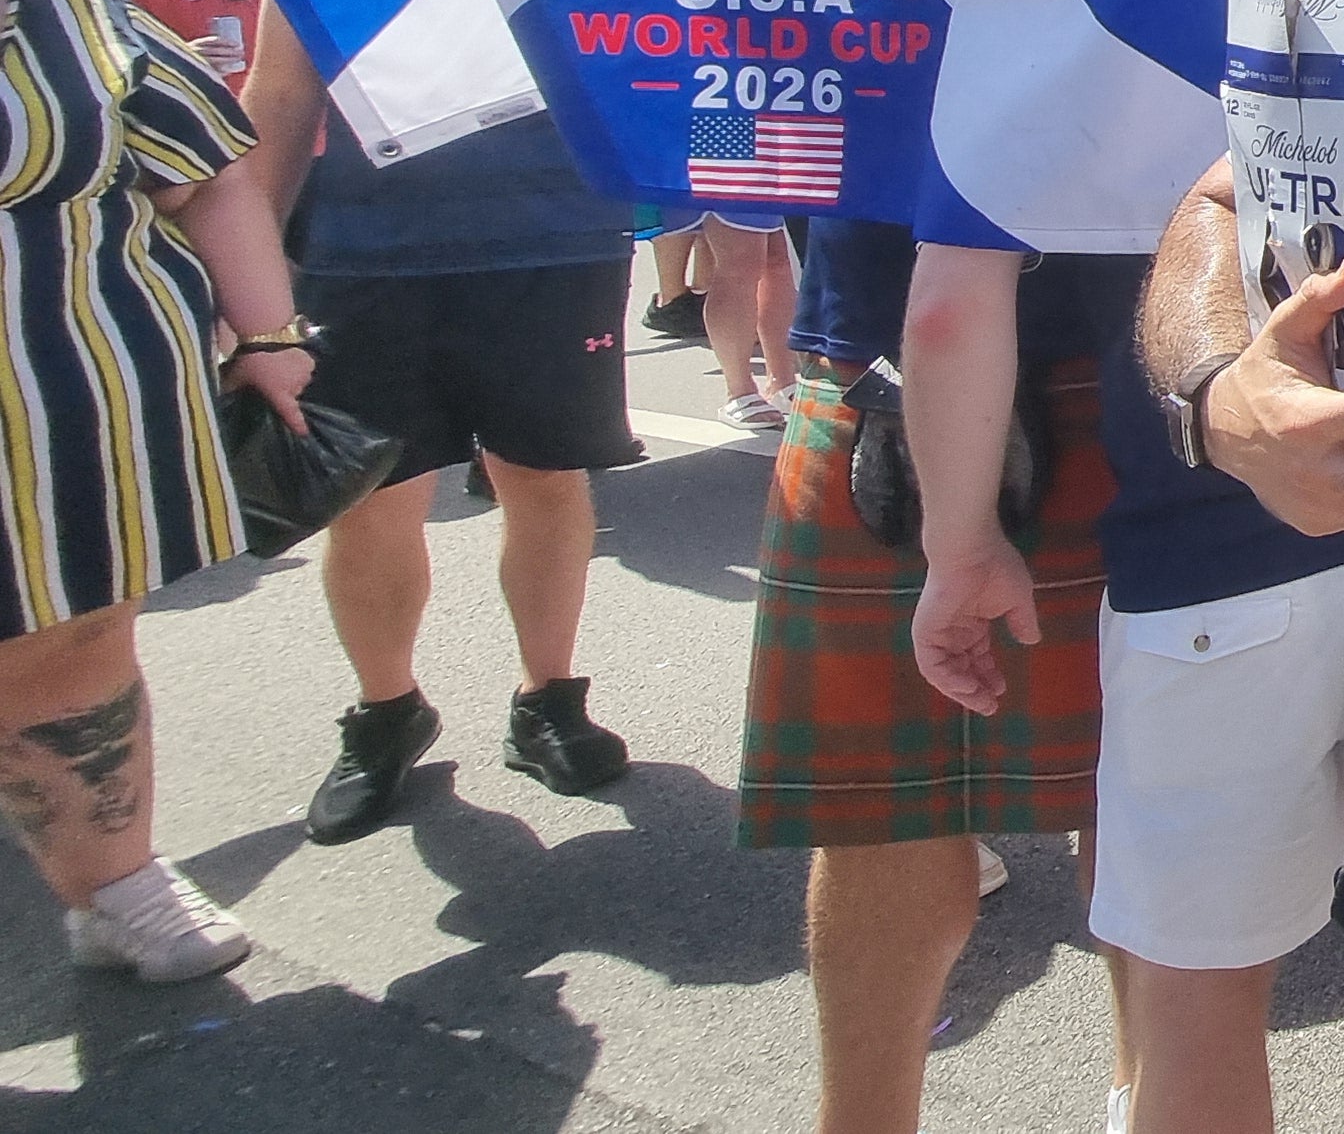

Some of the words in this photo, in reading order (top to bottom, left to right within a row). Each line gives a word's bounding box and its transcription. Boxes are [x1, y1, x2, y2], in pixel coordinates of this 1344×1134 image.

[568, 12, 810, 62] WORLD
[830, 19, 932, 65] CUP
[691, 64, 844, 114] 2026
[1226, 98, 1240, 116] 12
[1251, 124, 1338, 165] Michelob
